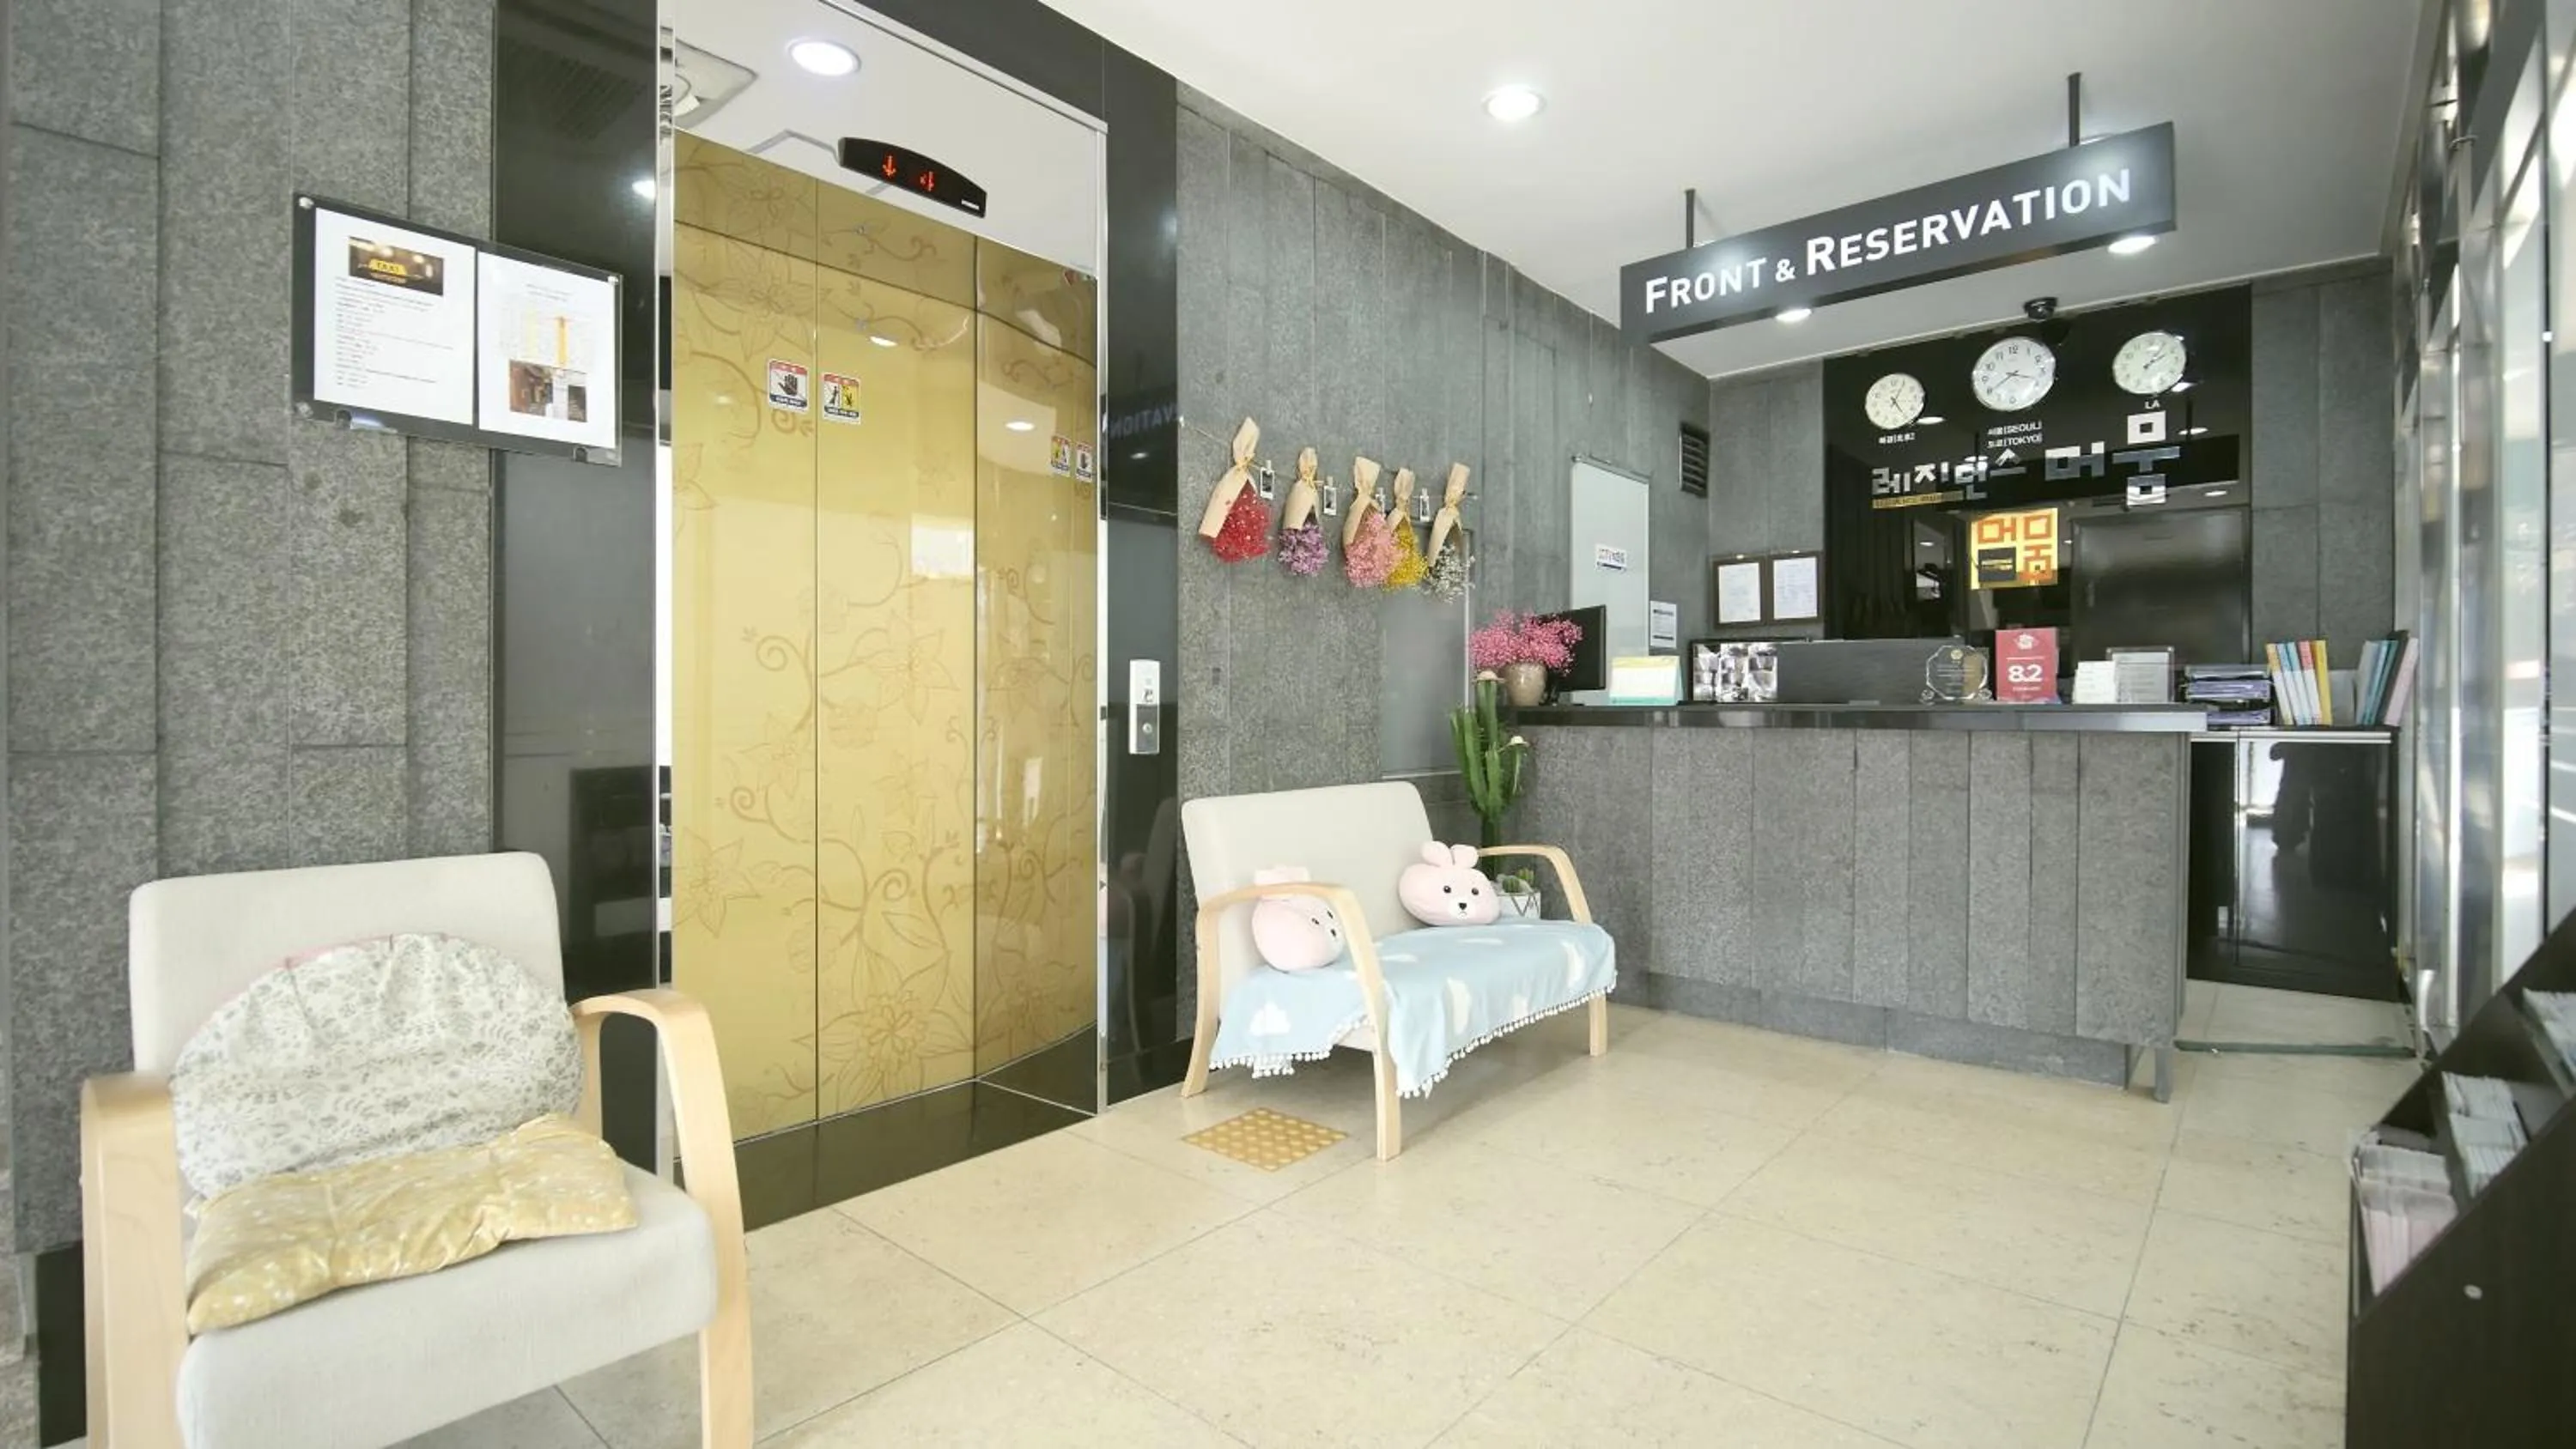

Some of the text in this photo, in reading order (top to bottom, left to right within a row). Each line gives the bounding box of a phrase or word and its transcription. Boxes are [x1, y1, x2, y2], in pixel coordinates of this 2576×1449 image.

[1644, 168, 2131, 314] FRONT & RESERVATION
[2145, 399, 2160, 409] LA
